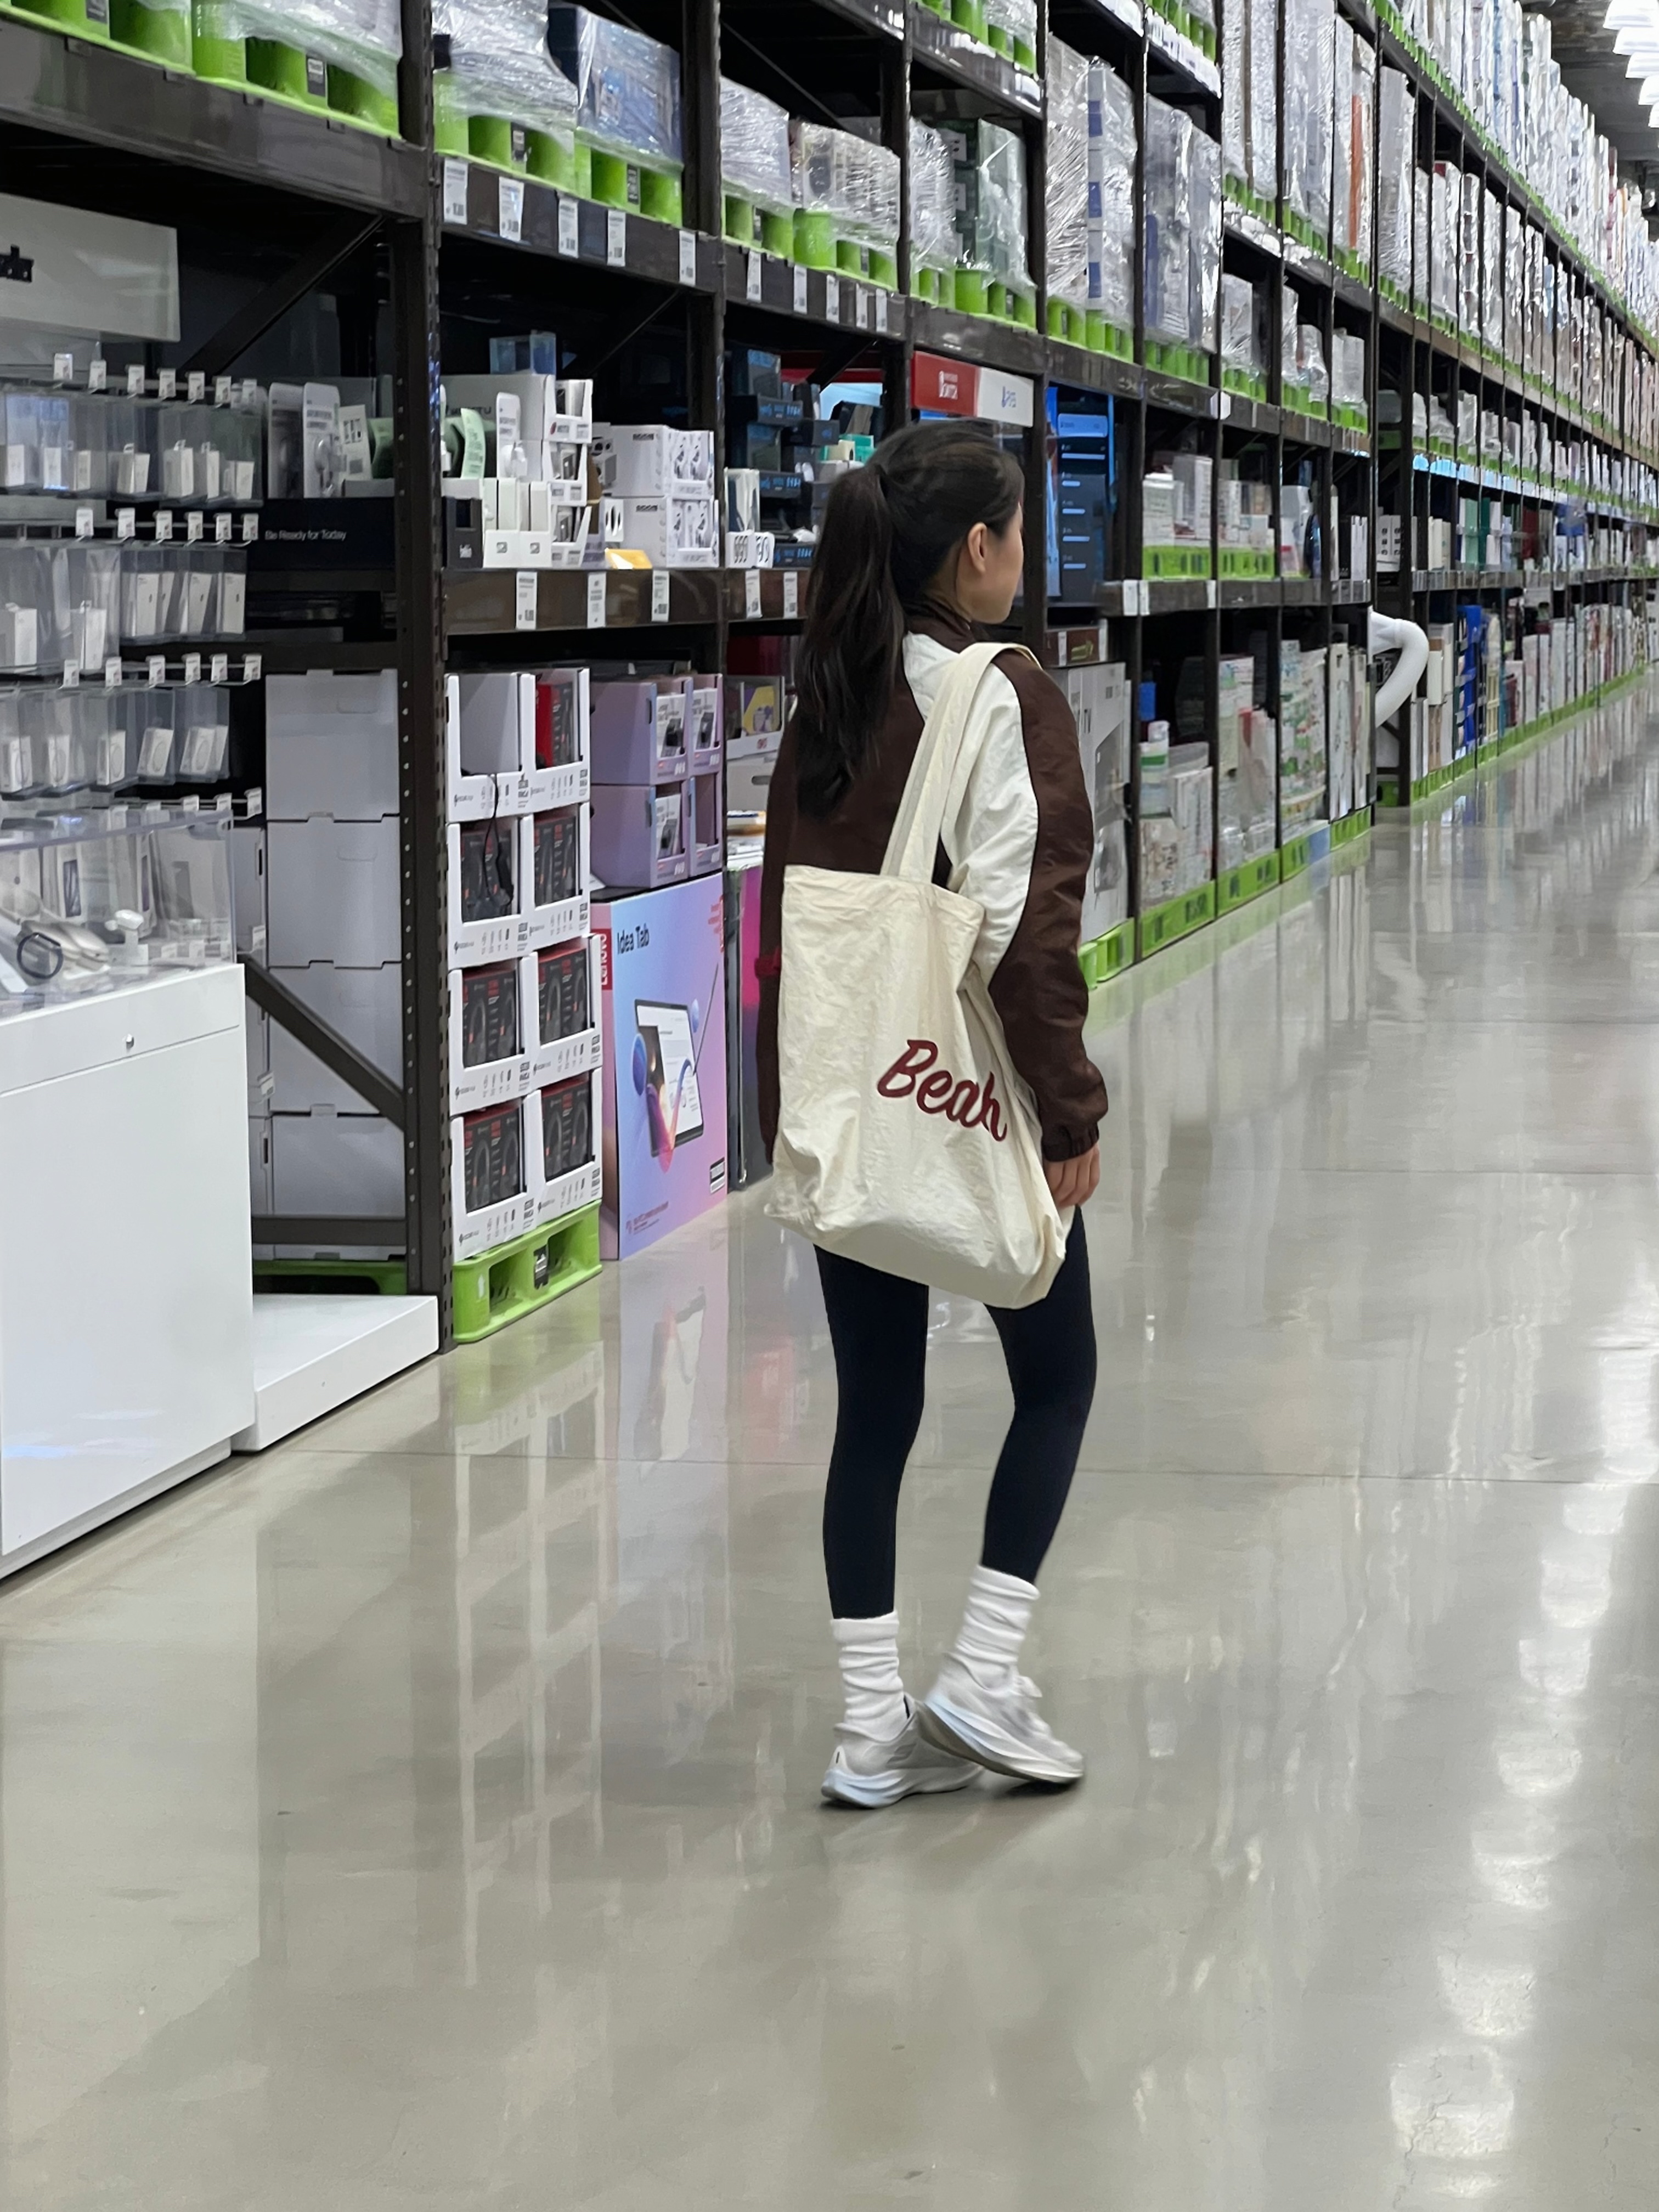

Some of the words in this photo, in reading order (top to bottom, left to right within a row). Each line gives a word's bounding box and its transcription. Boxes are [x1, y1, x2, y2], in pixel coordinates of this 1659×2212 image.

[279, 530, 306, 541] Ready
[321, 529, 347, 541] Today
[617, 929, 634, 955] Idea
[635, 923, 650, 949] Tab
